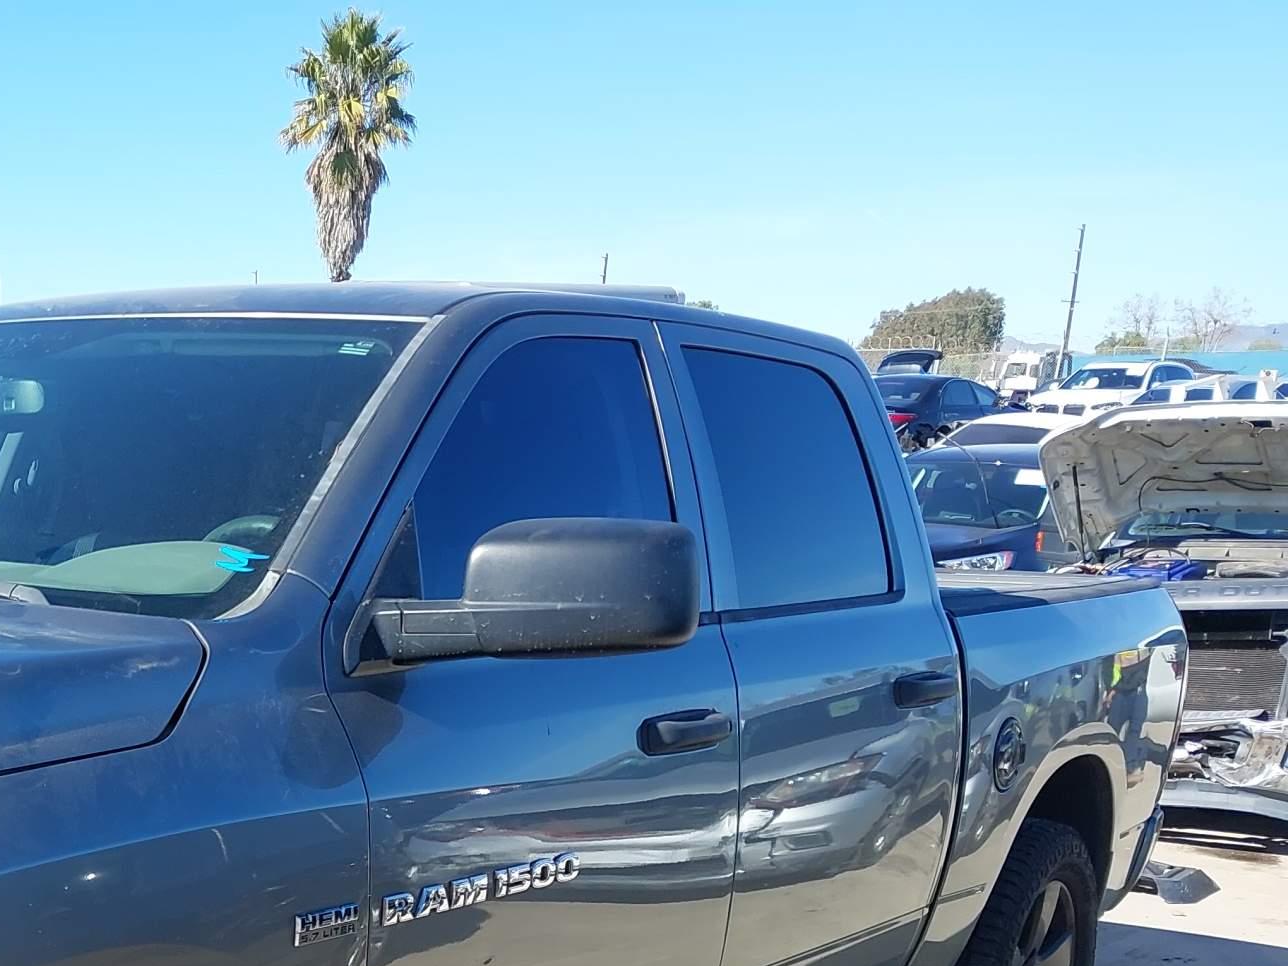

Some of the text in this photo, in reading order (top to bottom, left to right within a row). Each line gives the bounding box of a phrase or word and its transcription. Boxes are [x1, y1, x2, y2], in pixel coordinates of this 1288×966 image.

[382, 851, 581, 926] RAM 1500
[297, 904, 359, 932] HEMI
[300, 924, 356, 943] 5.7 LITER
